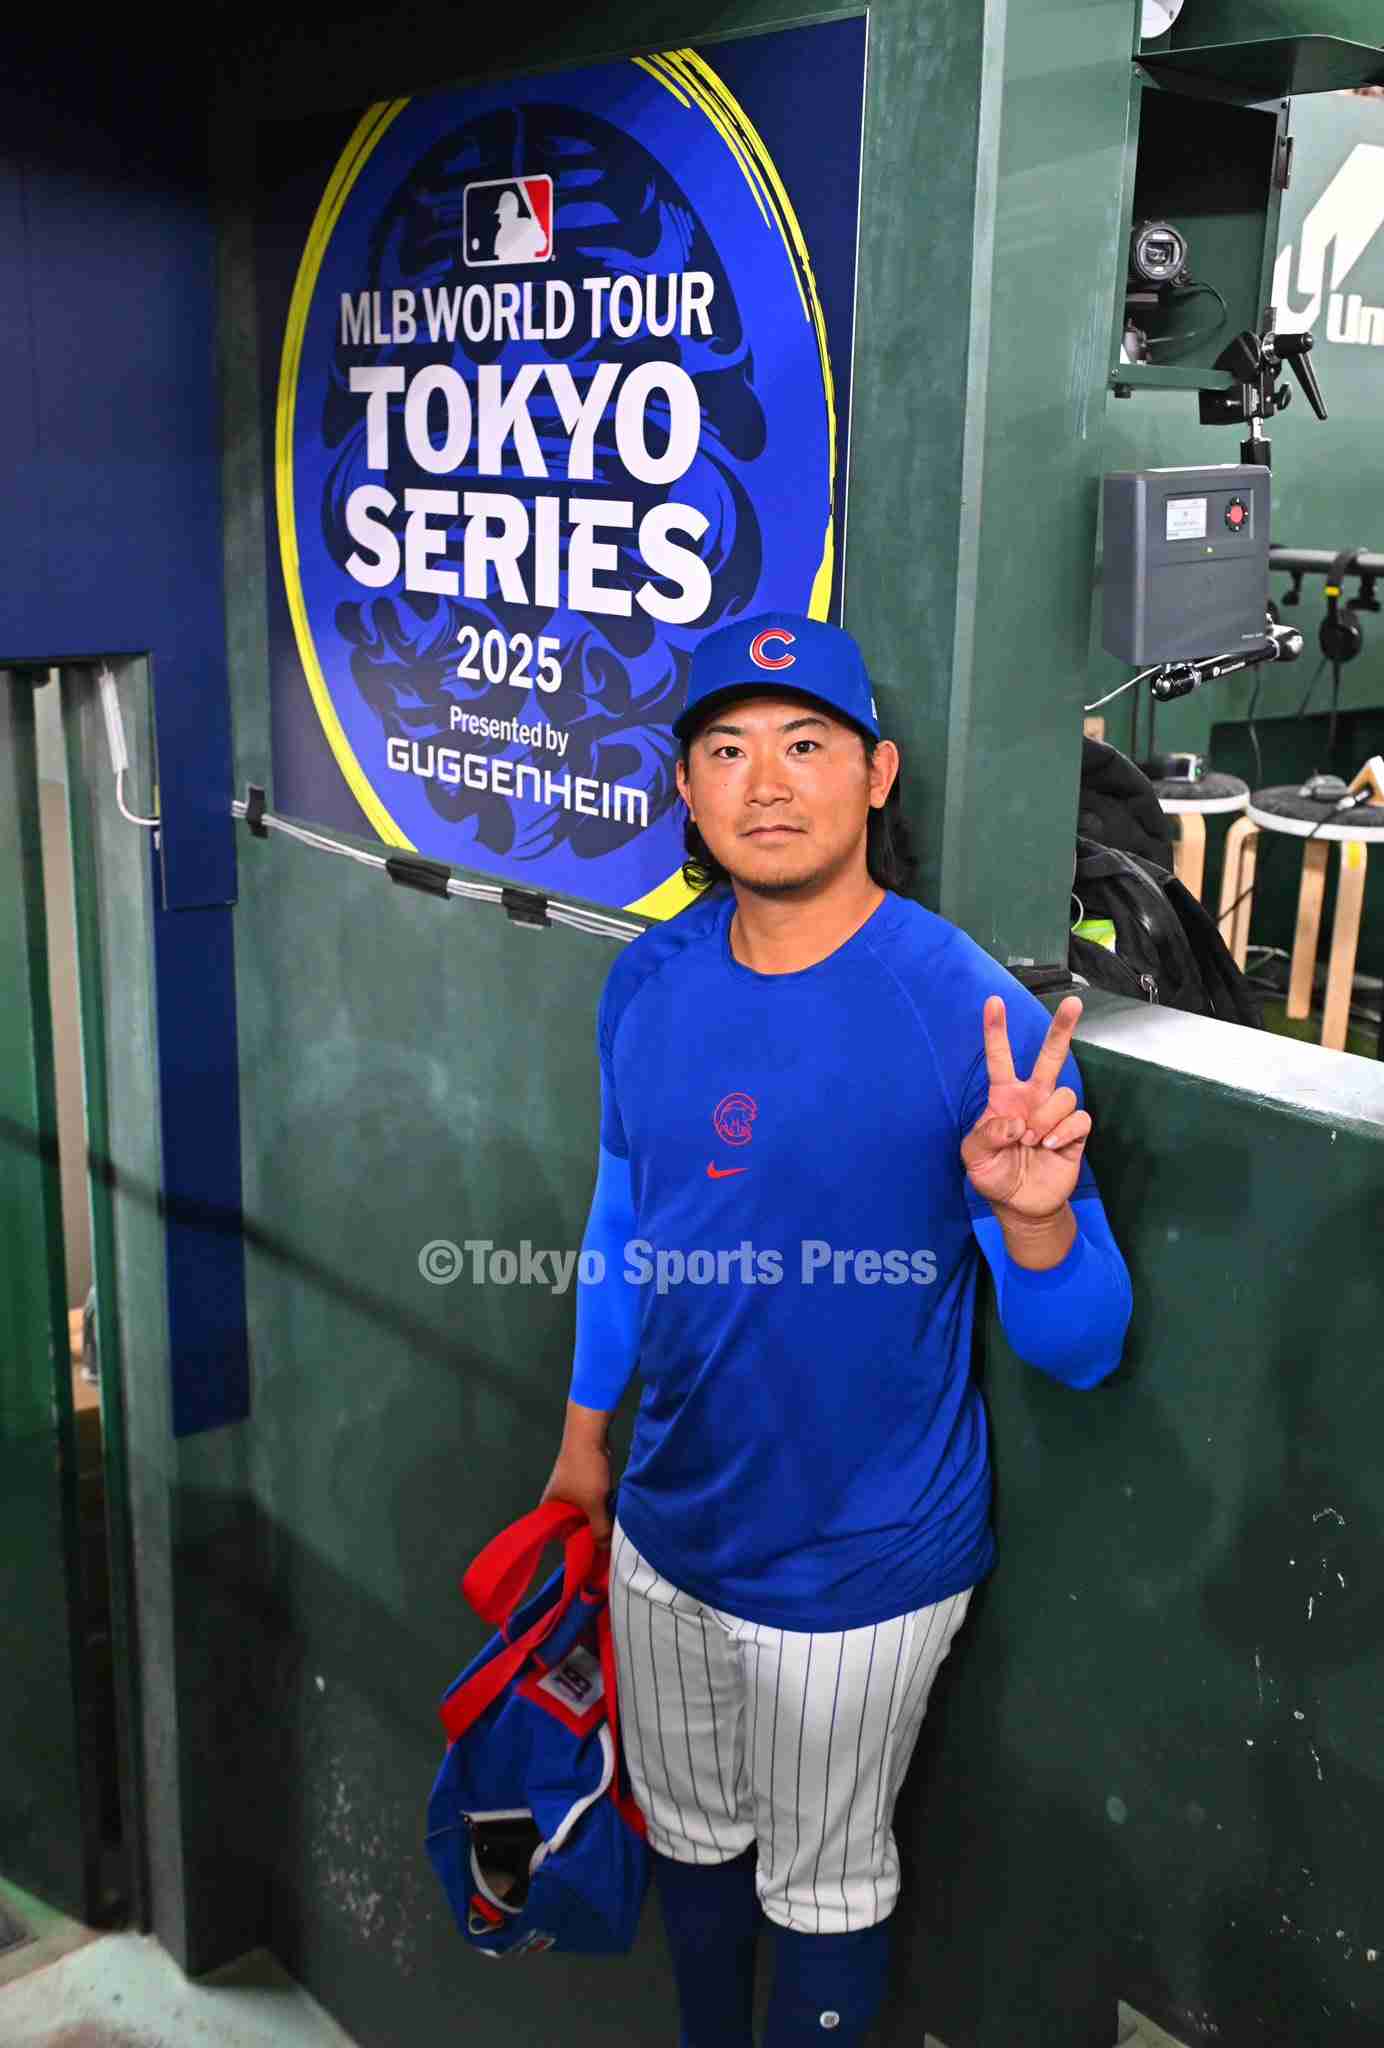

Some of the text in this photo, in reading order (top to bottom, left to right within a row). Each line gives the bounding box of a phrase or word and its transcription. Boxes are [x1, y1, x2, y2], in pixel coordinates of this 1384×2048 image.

[340, 270, 716, 345] MLB WORLD TOUR
[348, 360, 702, 486] TOKYO
[344, 483, 713, 625] SERIES
[456, 625, 563, 693] 2025
[749, 627, 797, 670] C
[449, 704, 570, 757] Presented by
